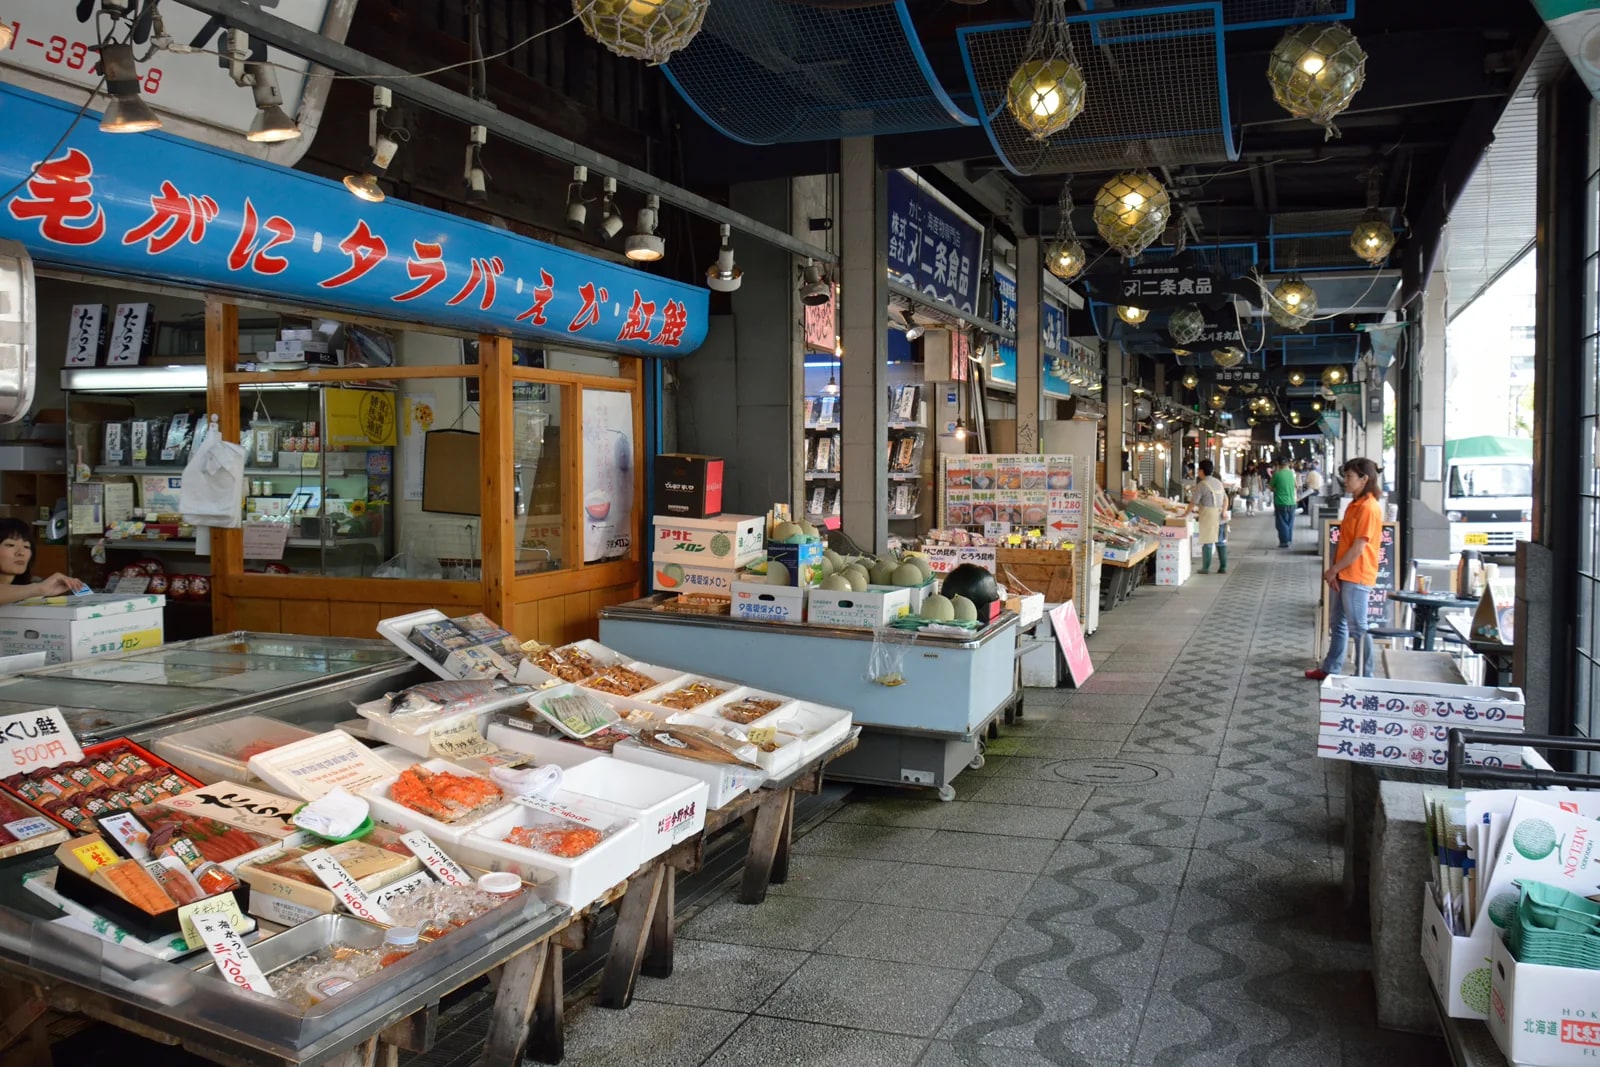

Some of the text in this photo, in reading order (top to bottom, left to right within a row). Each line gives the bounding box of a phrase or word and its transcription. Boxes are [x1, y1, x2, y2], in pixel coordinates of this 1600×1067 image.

[77, 309, 93, 362] たらこ
[119, 308, 138, 360] たらこ
[660, 528, 693, 541] アサヒ
[673, 542, 705, 552] メロン
[12, 739, 67, 766] 500円
[1563, 825, 1588, 879] MELON
[1523, 1018, 1557, 1036] 北海道
